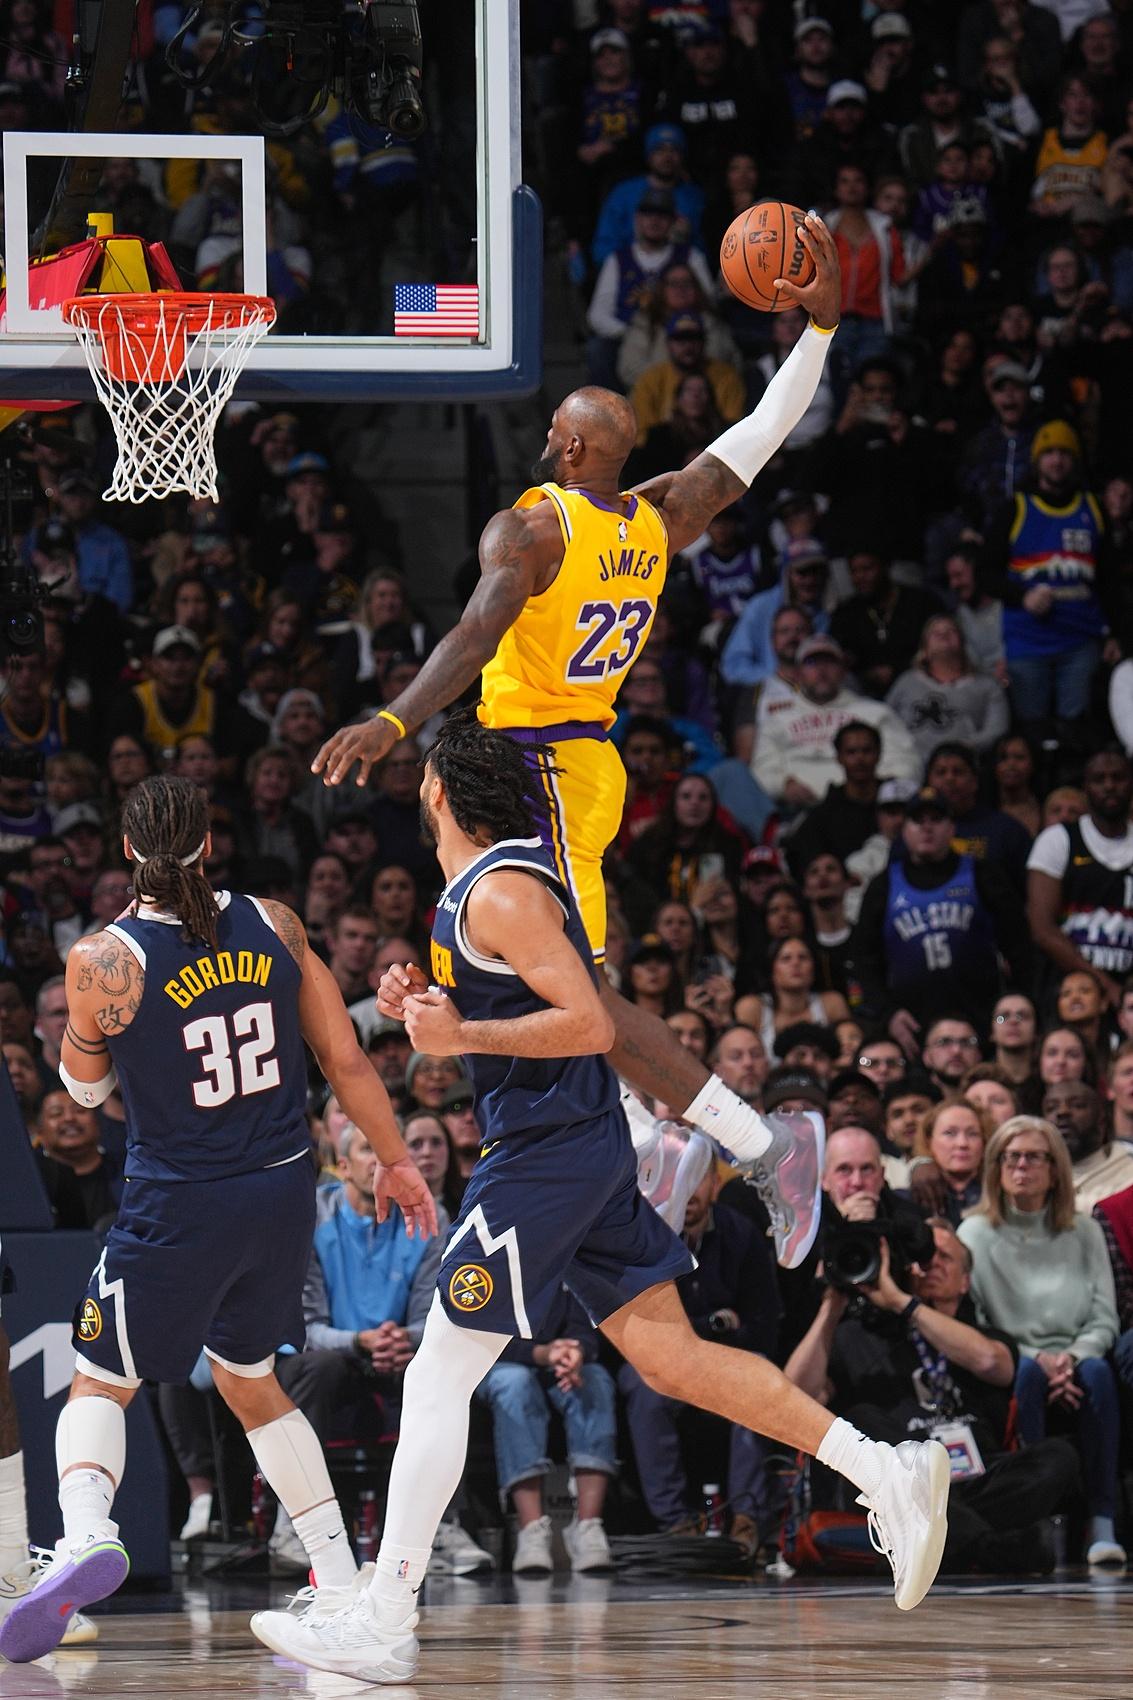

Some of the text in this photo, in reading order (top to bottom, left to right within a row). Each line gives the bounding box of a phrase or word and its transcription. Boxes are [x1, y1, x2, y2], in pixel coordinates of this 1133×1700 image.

[789, 209, 808, 276] Wson
[598, 549, 660, 582] JAMES
[565, 598, 653, 684] 23
[163, 950, 273, 1010] GORDON
[921, 931, 953, 972] 15
[181, 1000, 282, 1110] 32
